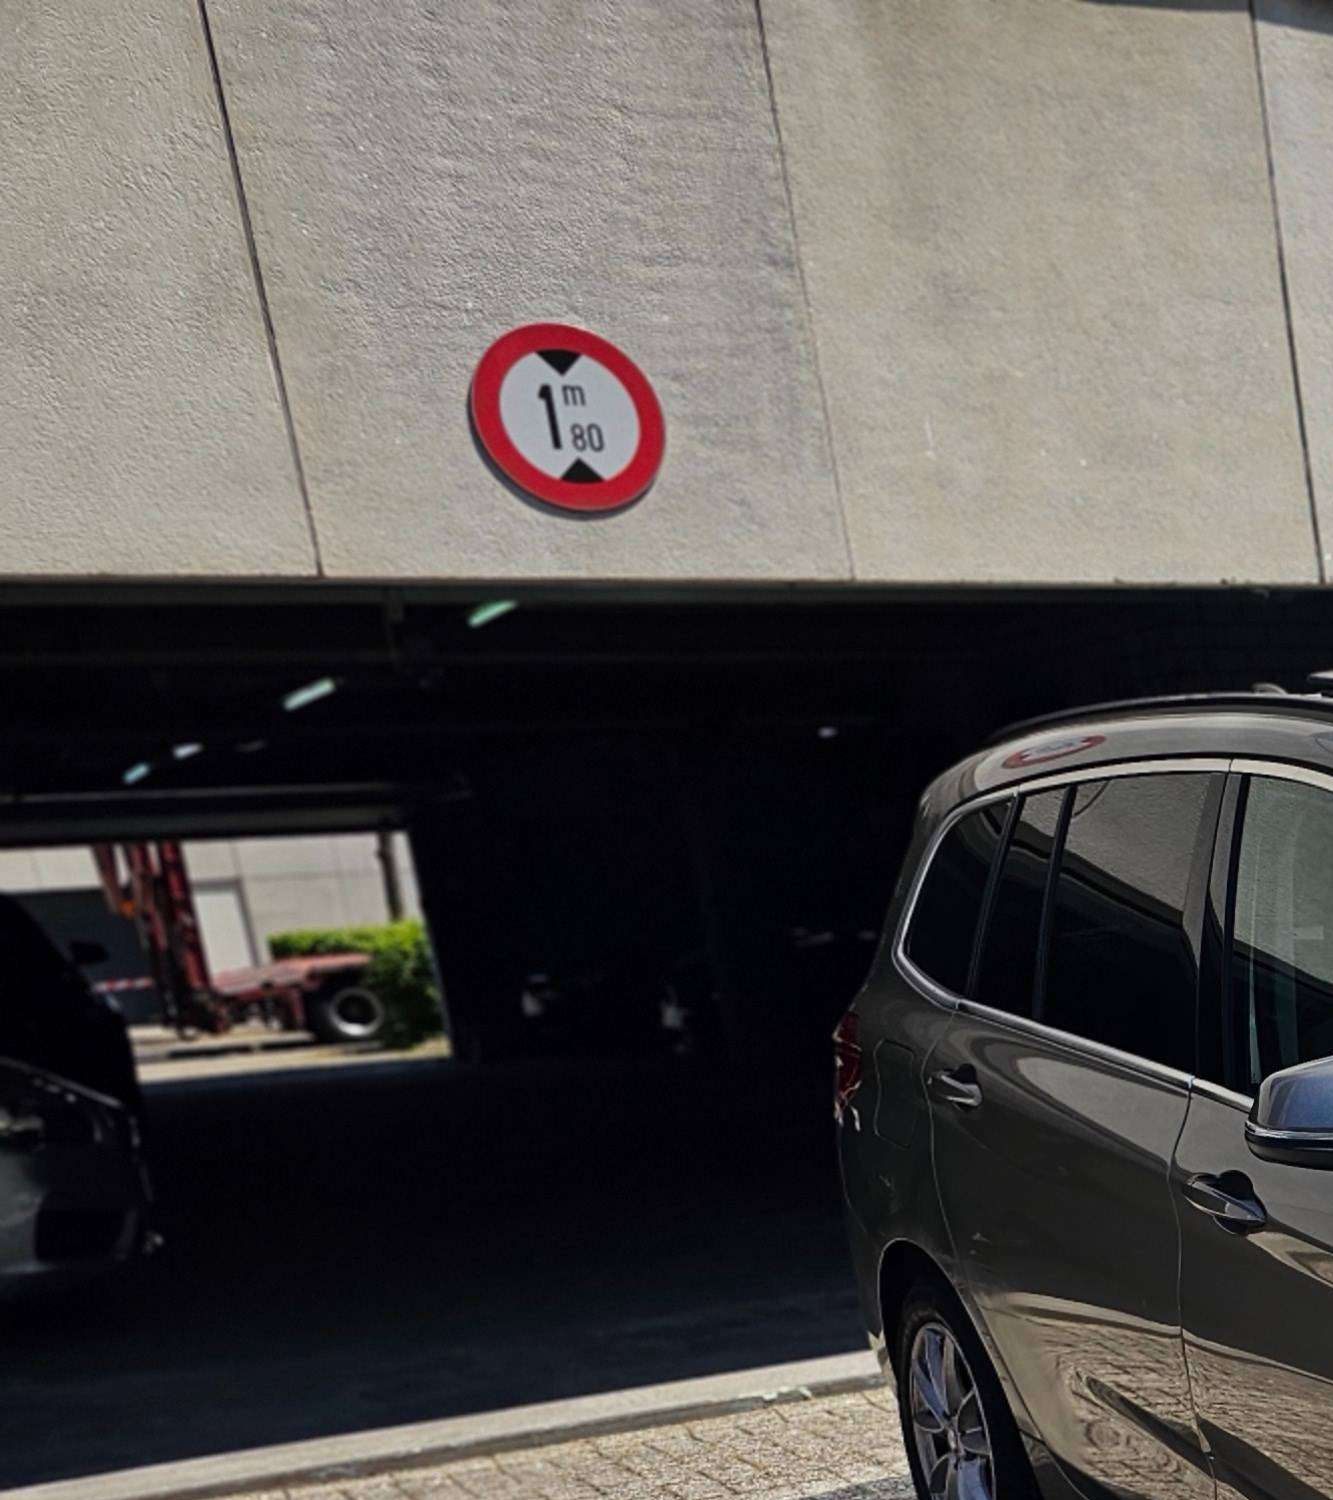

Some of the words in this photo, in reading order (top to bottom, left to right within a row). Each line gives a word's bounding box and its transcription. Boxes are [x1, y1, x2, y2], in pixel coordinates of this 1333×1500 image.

[561, 384, 586, 406] m
[537, 383, 562, 450] 1
[570, 423, 605, 452] 80
